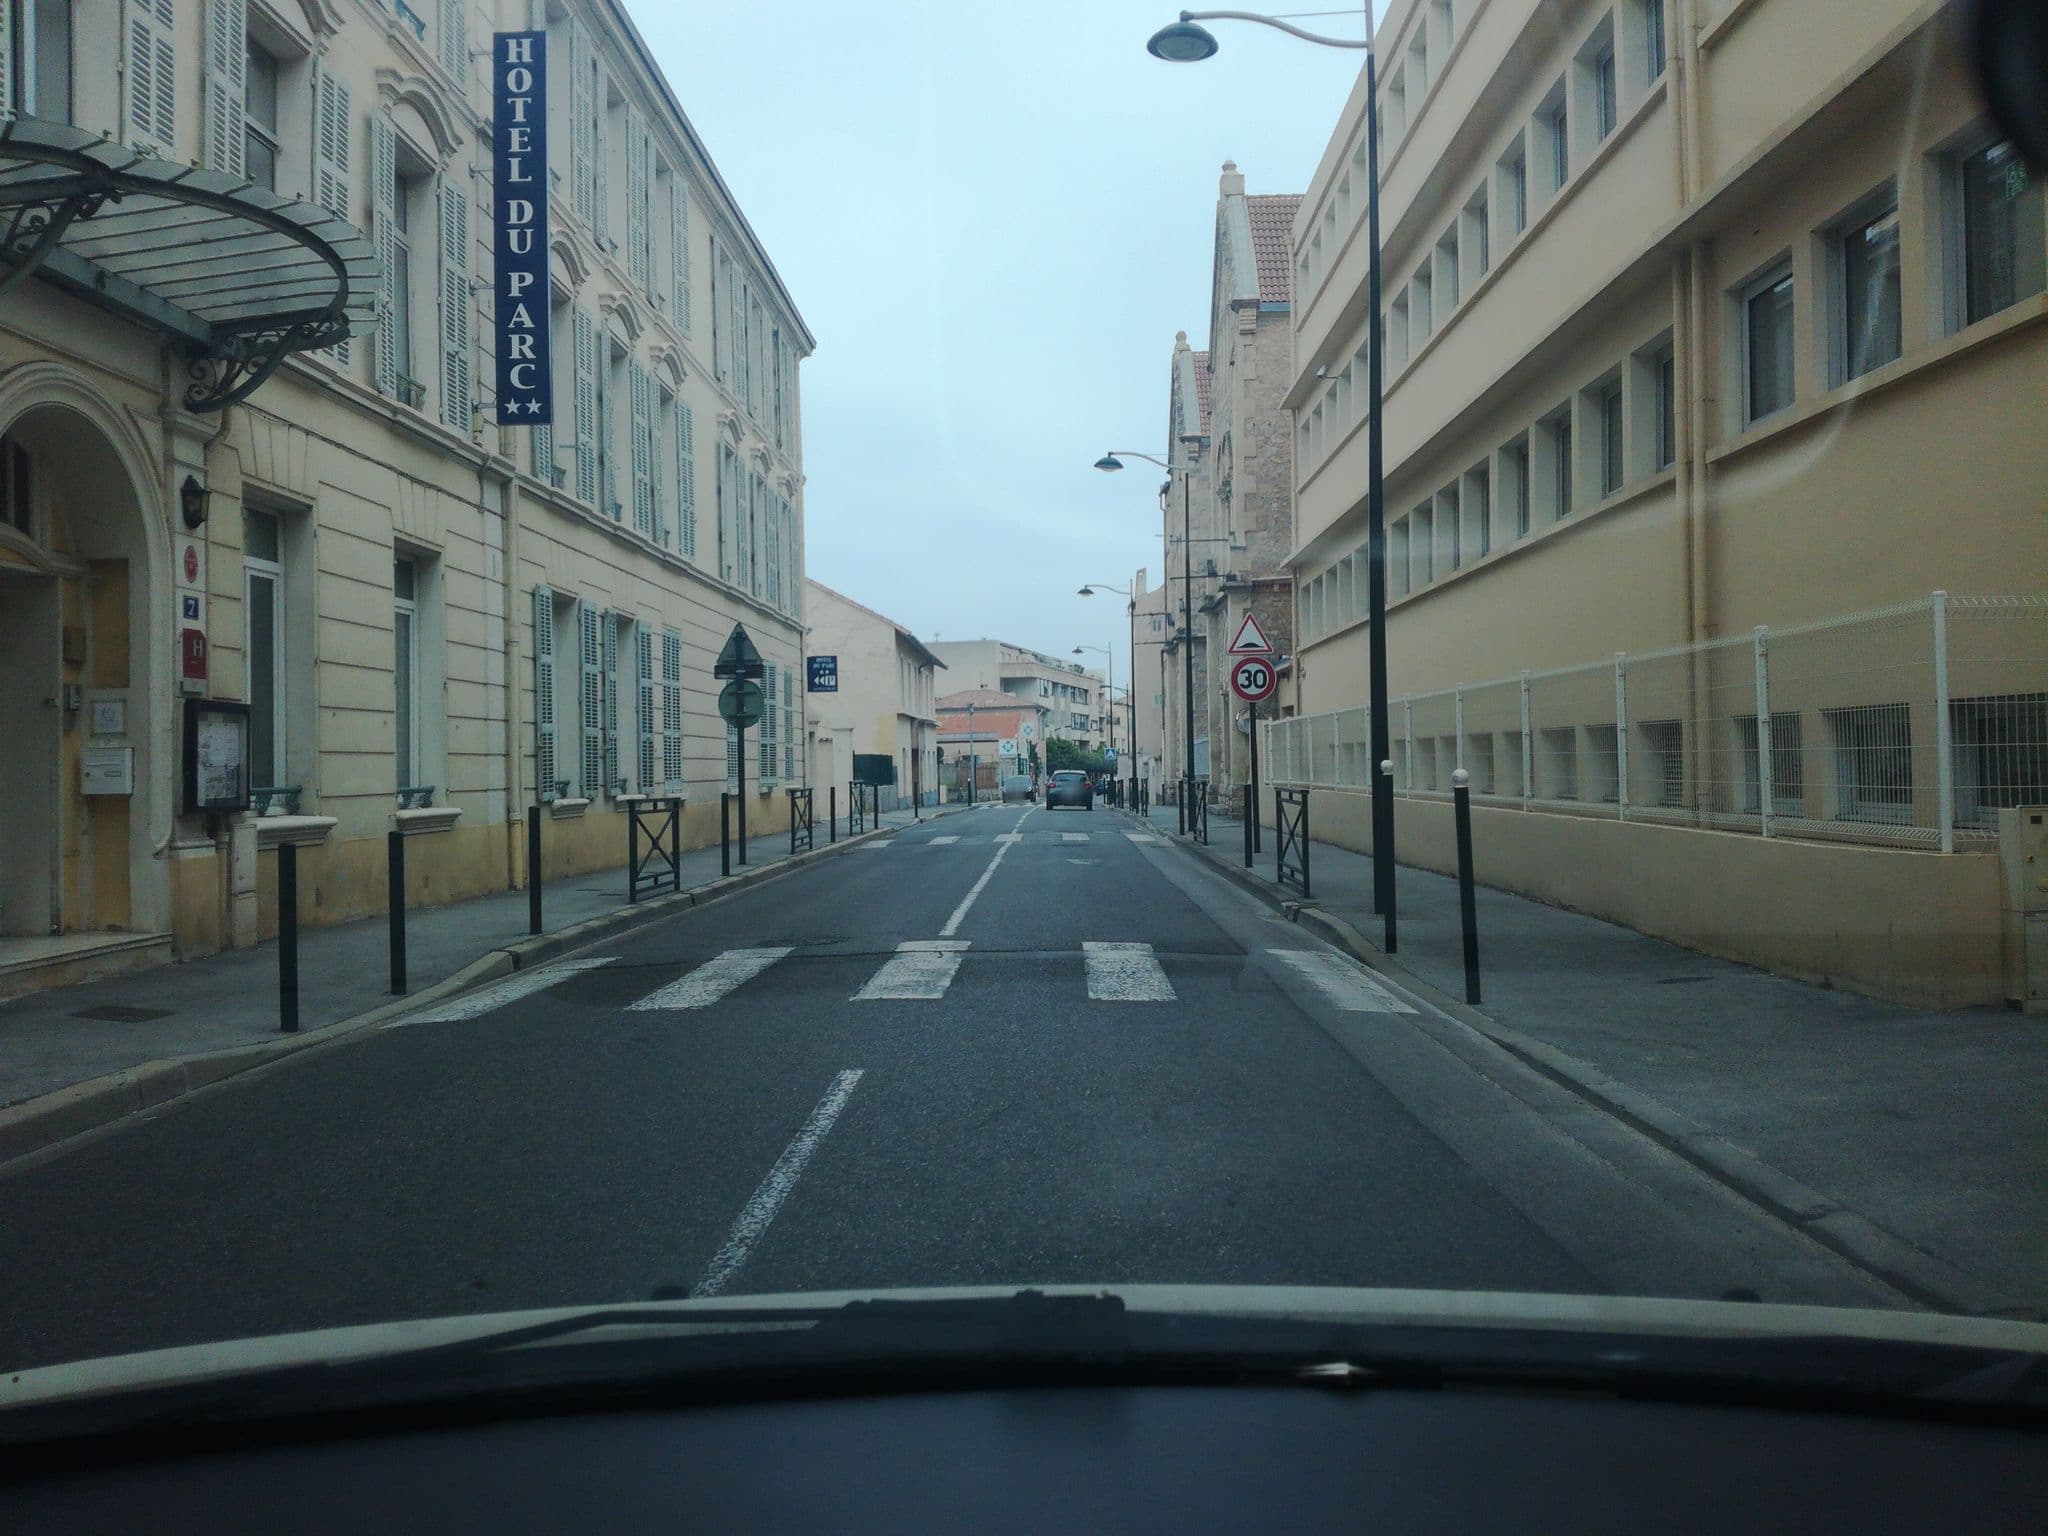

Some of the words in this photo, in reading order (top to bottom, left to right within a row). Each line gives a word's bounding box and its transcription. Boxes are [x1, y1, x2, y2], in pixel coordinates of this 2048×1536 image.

[505, 38, 534, 182] HOTEL
[506, 199, 535, 254] DU
[507, 271, 537, 389] PARC
[187, 600, 195, 616] 7
[1240, 669, 1267, 689] 30
